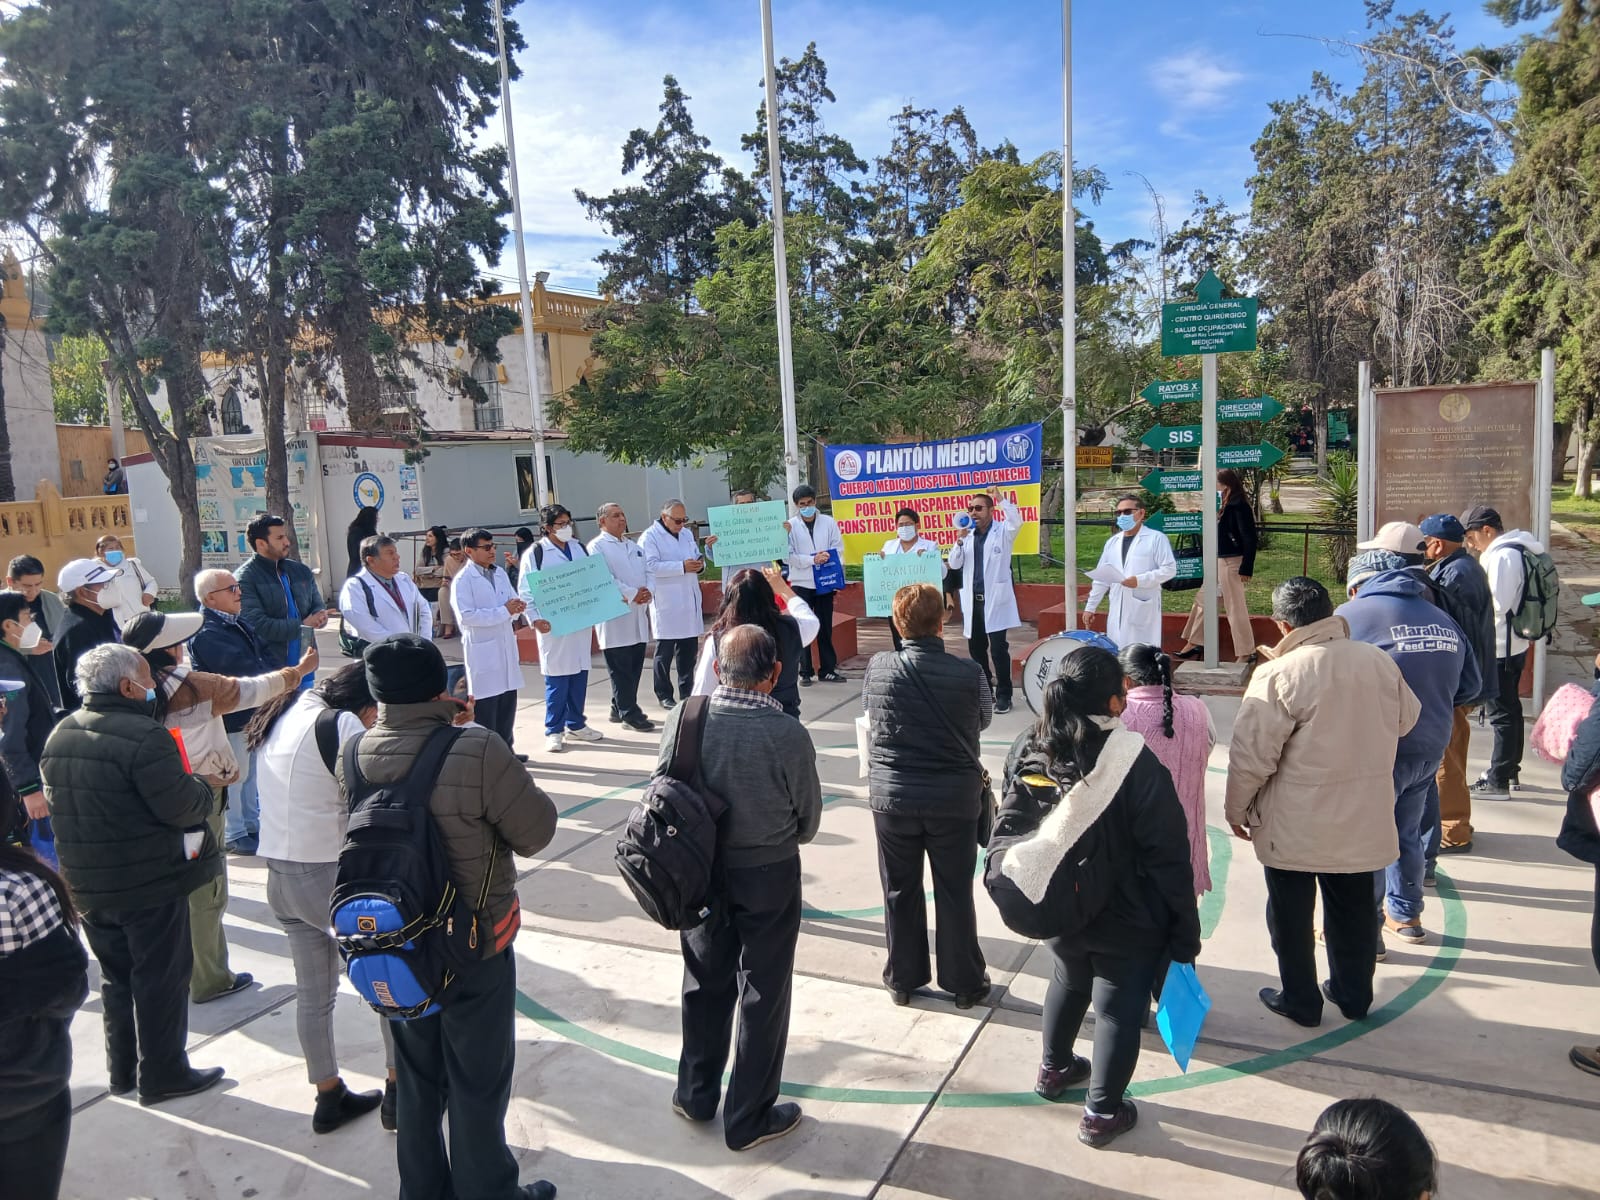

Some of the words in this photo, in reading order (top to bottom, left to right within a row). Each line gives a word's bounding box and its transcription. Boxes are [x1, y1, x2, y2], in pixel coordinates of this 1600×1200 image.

[1209, 302, 1241, 310] GENERAL
[1175, 315, 1202, 323] CENTRO
[1198, 323, 1247, 332] OCUPACIONAL
[1191, 338, 1224, 346] MEDICINA
[1158, 383, 1188, 393] RAYOS
[1191, 382, 1198, 390] X
[1220, 402, 1263, 411] DIRECCIÓN
[1169, 430, 1194, 443] SIS
[866, 443, 933, 475] PLANTÓN
[936, 439, 997, 468] MÉDICO
[839, 480, 875, 496] CUERPO
[876, 477, 912, 493] MÉDICO
[913, 472, 959, 490] HOSPITAL
[960, 471, 971, 486] III
[973, 466, 1031, 485] GOYENECHE
[855, 502, 877, 517] POR
[879, 501, 893, 516] LA
[923, 513, 943, 530] DEL
[1390, 624, 1458, 642] Marathon
[1397, 640, 1424, 651] Feed
[1436, 640, 1458, 652] Grain
